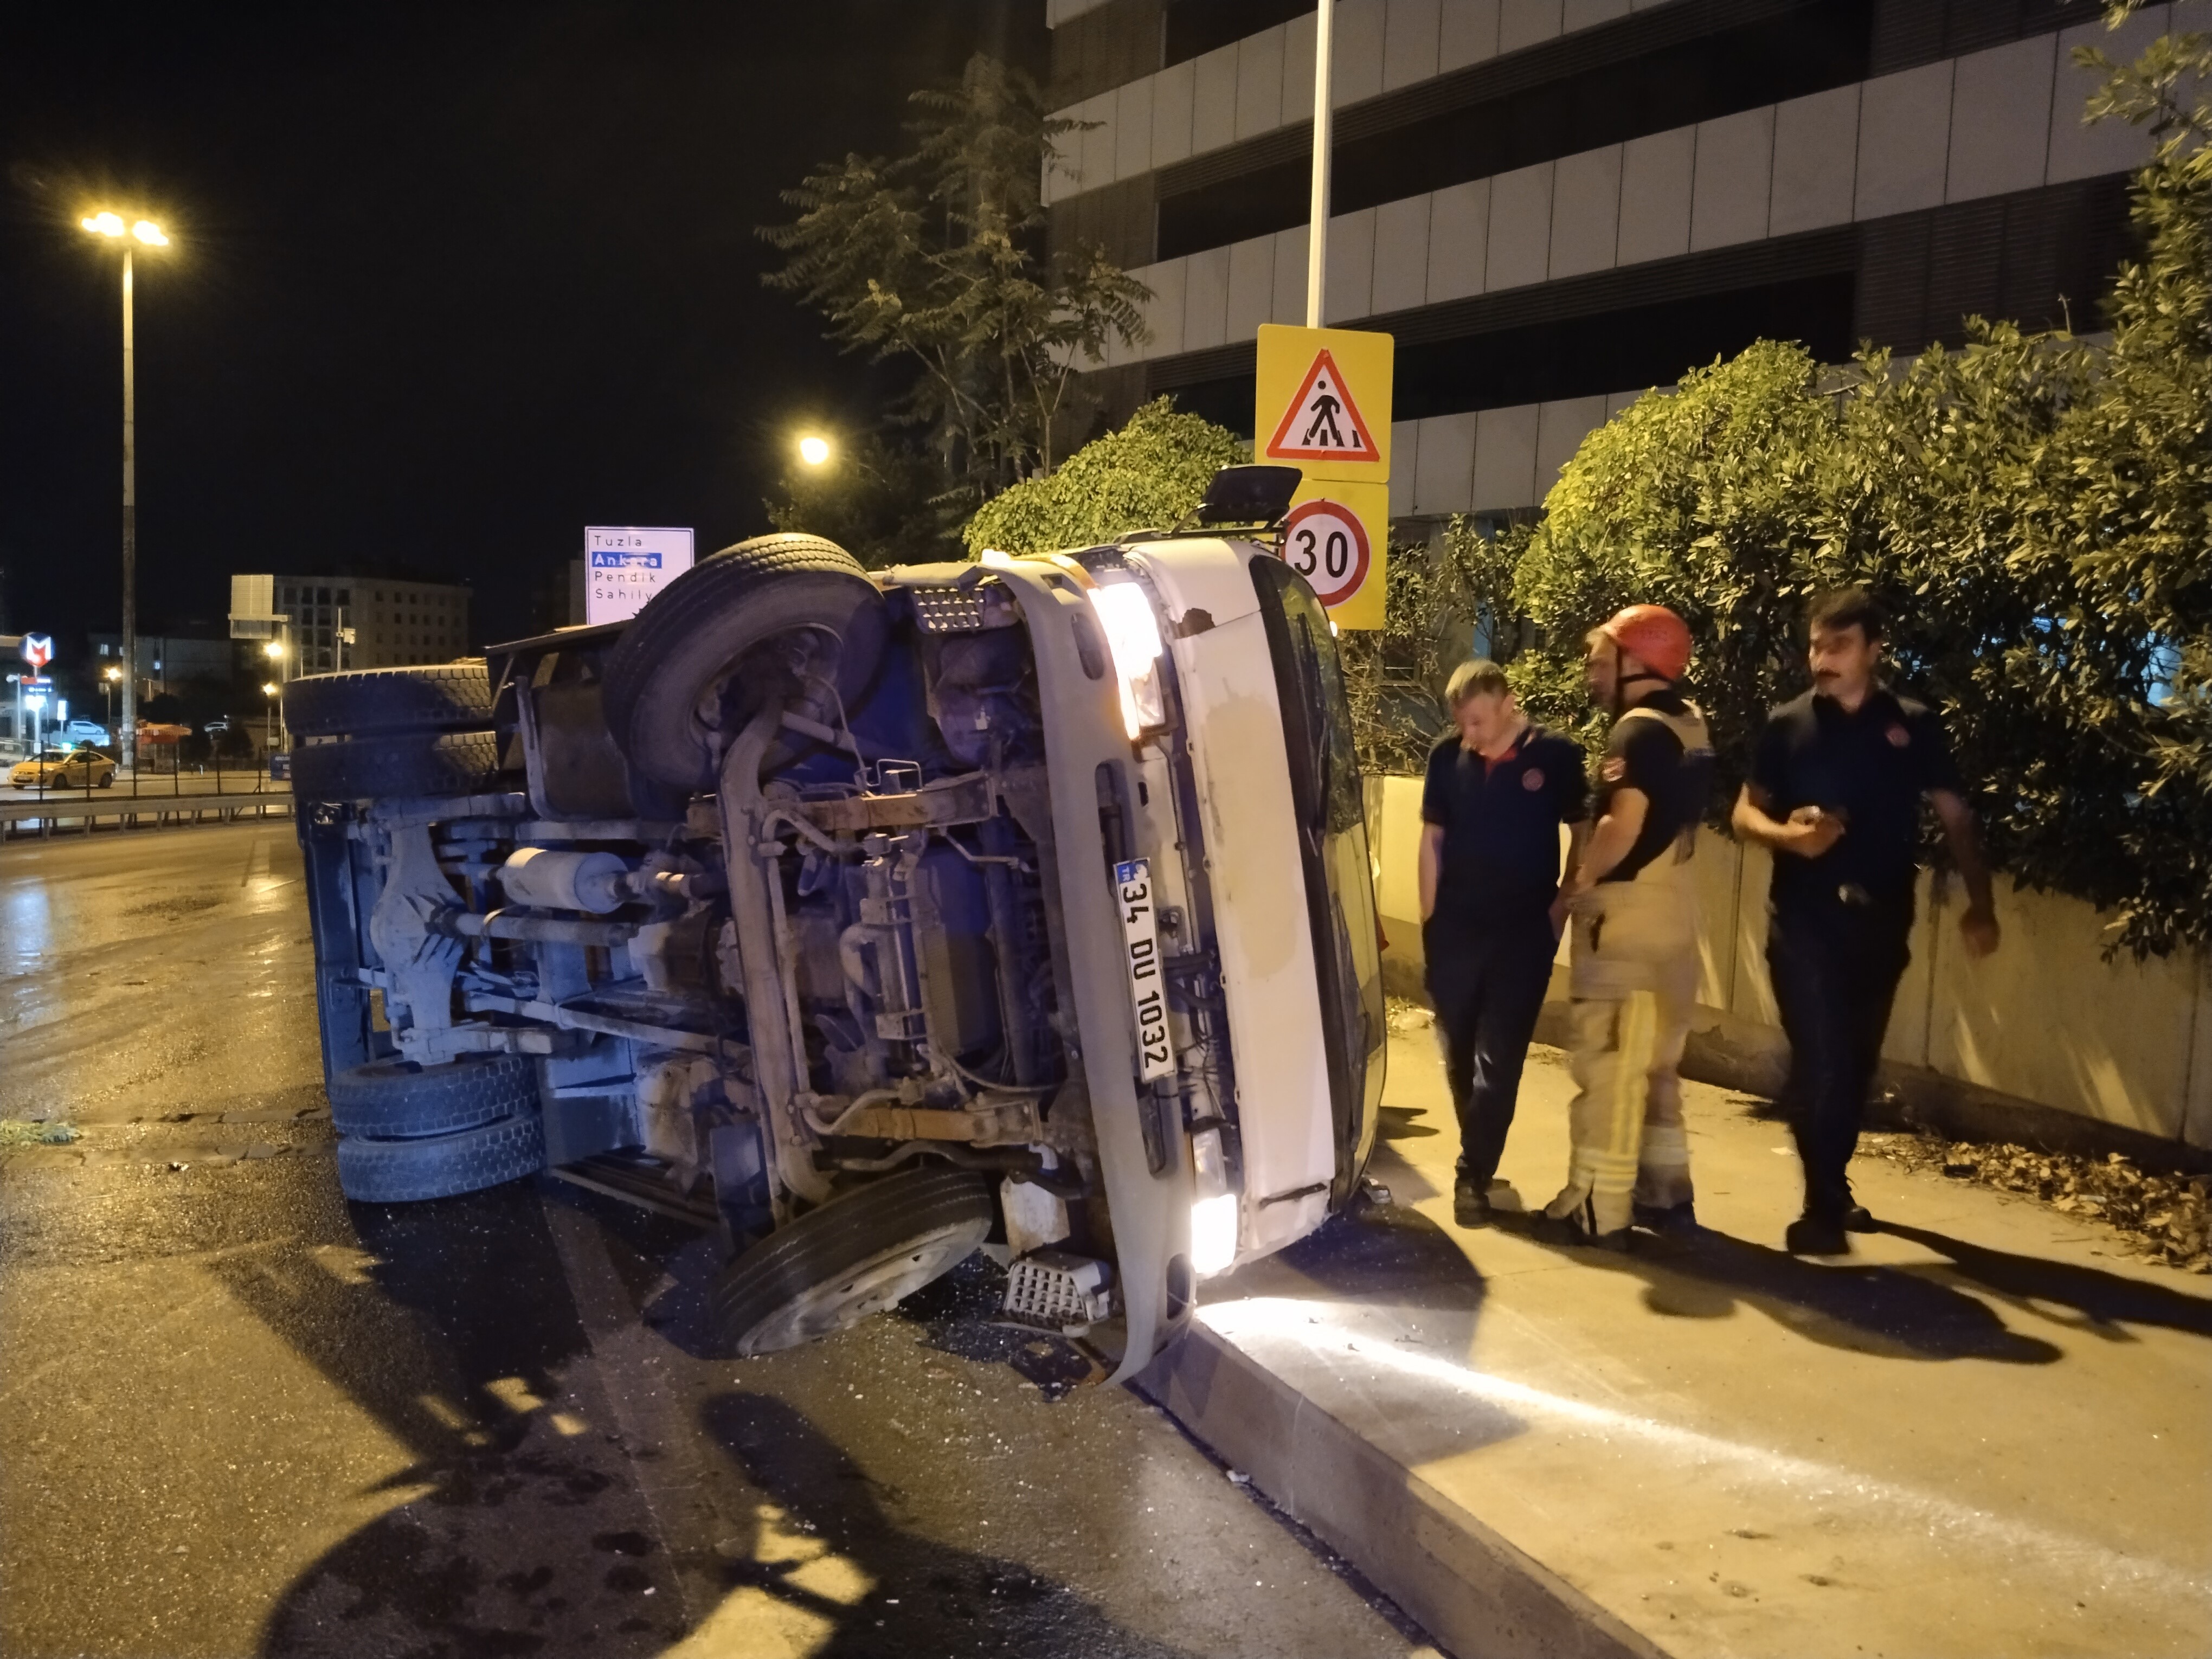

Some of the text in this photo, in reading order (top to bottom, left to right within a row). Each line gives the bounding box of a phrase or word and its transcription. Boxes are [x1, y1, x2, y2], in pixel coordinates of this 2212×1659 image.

[594, 535, 642, 546] Tuzla
[1294, 529, 1348, 578] 30
[594, 571, 656, 583] Pendik
[1121, 866, 1131, 882] TR
[1122, 883, 1168, 1069] 34 DU 1032
